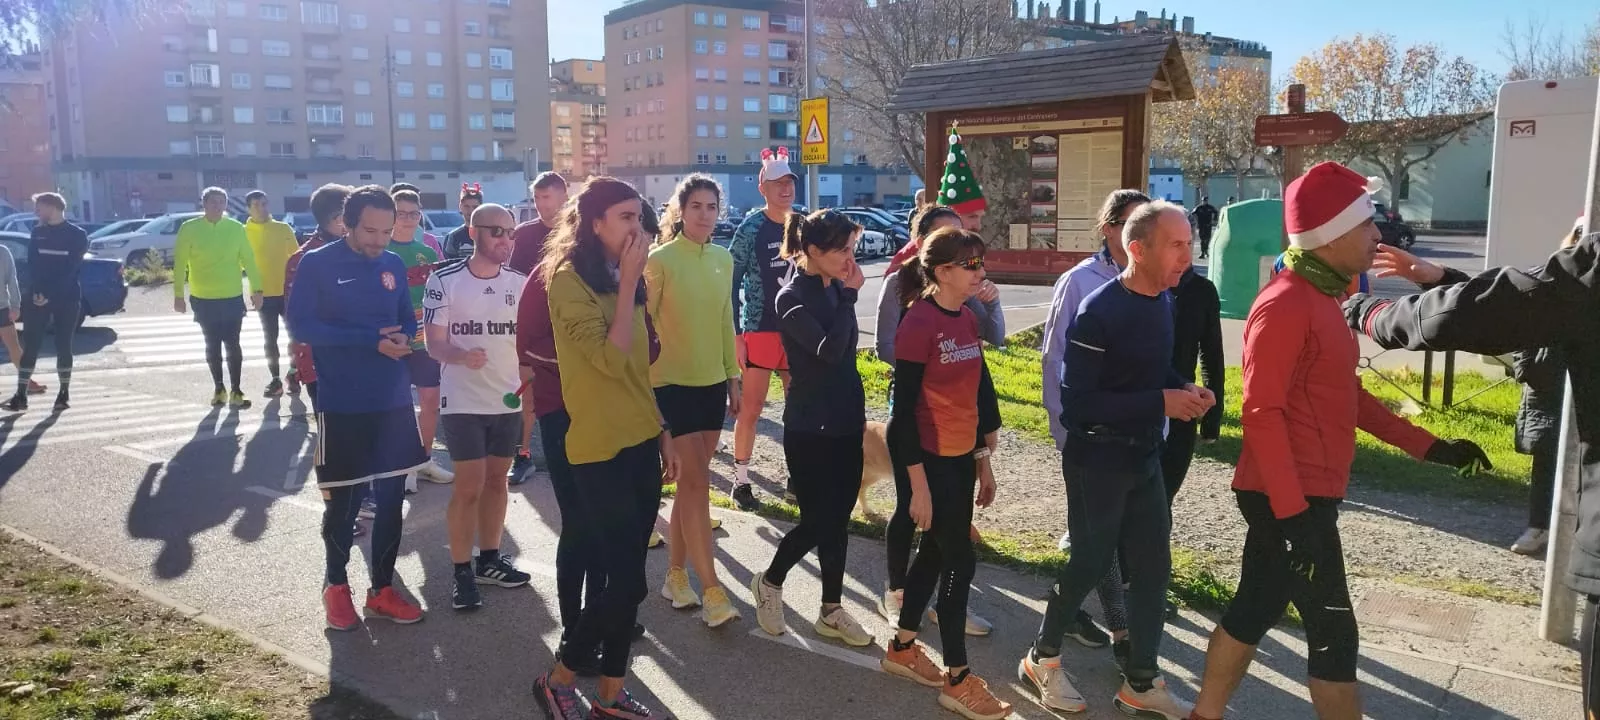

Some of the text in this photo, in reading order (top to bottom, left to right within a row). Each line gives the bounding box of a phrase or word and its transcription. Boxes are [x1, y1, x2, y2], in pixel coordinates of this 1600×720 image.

[451, 320, 517, 336] cola turk
[938, 337, 958, 353] 10K
